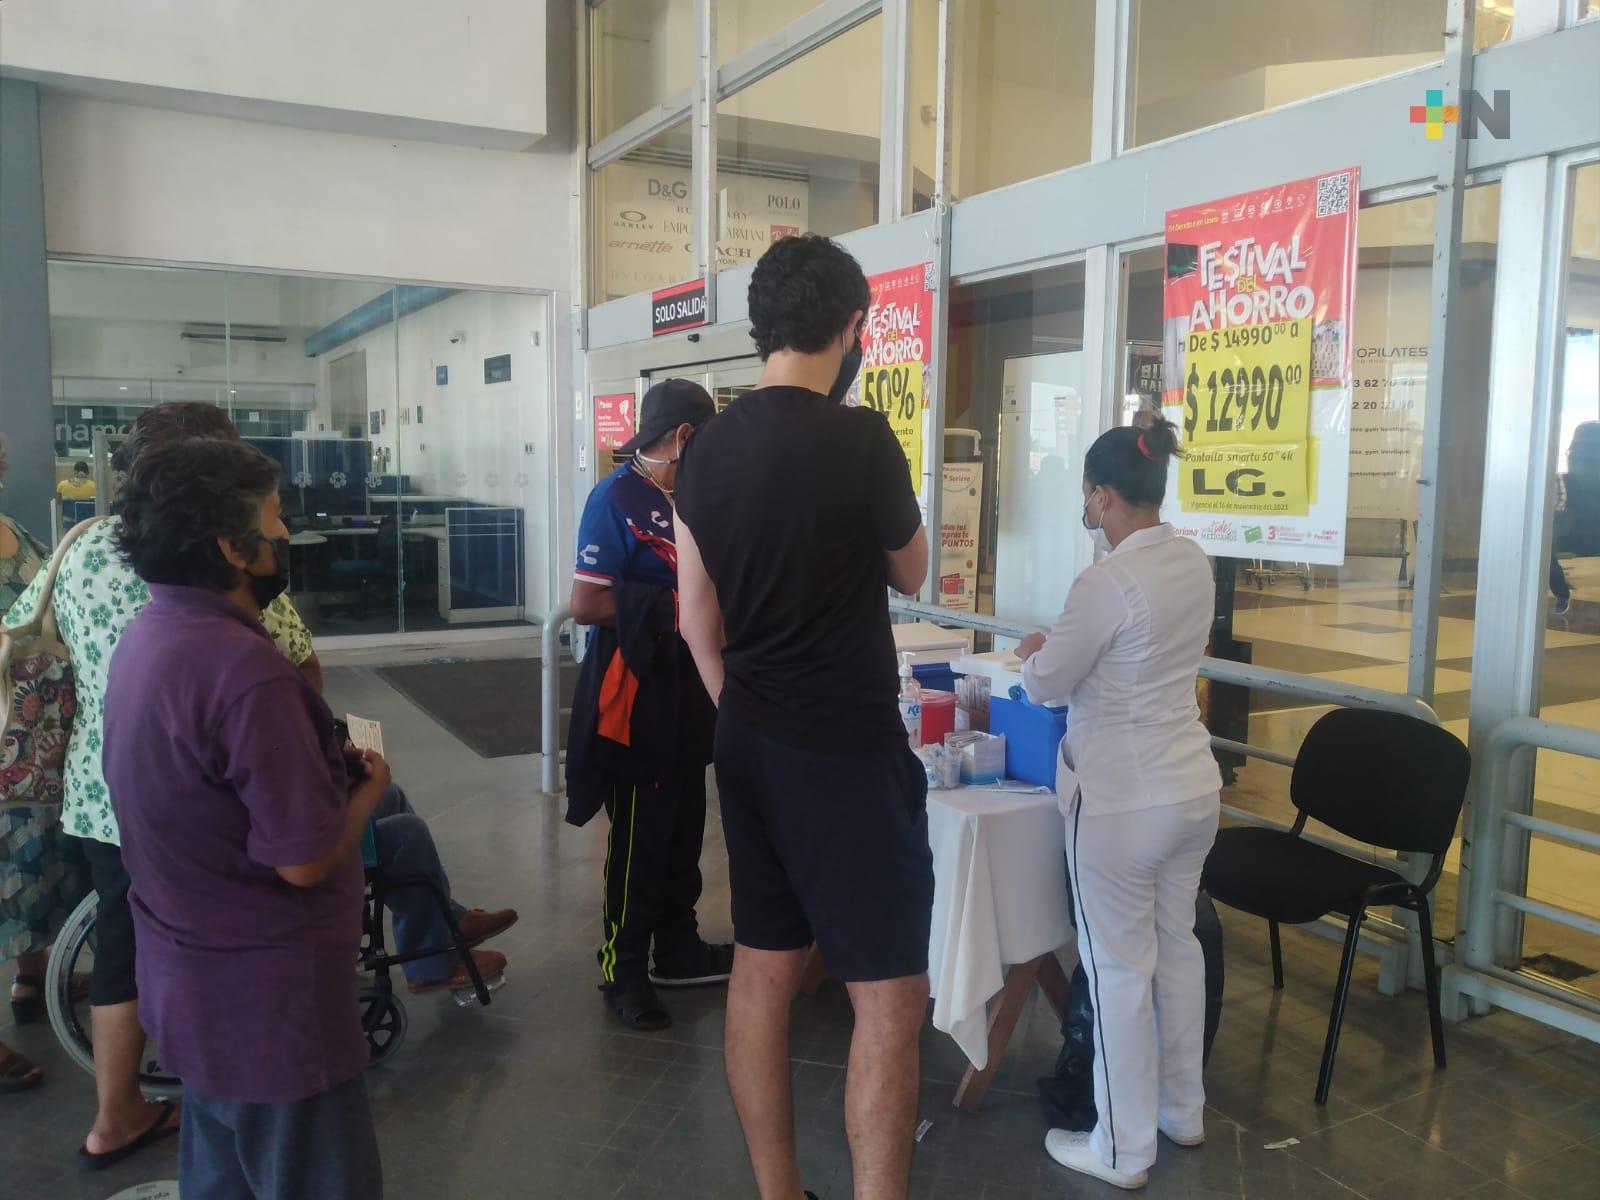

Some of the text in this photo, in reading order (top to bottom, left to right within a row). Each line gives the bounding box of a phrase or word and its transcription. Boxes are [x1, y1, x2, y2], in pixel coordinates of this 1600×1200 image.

[647, 178, 687, 199] D&G
[767, 194, 801, 210] POLO
[608, 240, 674, 254] arnette
[1200, 235, 1307, 292] FESTIVAL
[1237, 274, 1257, 293] DEL
[656, 295, 706, 323] SOLO SALIDA
[1189, 285, 1315, 331] AHORRO
[868, 302, 920, 339] FESTIVAL
[1189, 335, 1207, 352] De
[1290, 322, 1299, 338] a
[864, 335, 923, 367] AHORRO
[1356, 346, 1429, 358] OPILATES
[1364, 379, 1378, 388] 62
[1363, 401, 1377, 410] 20
[1185, 452, 1223, 462] Pantalla
[942, 539, 974, 548] PUNTOS
